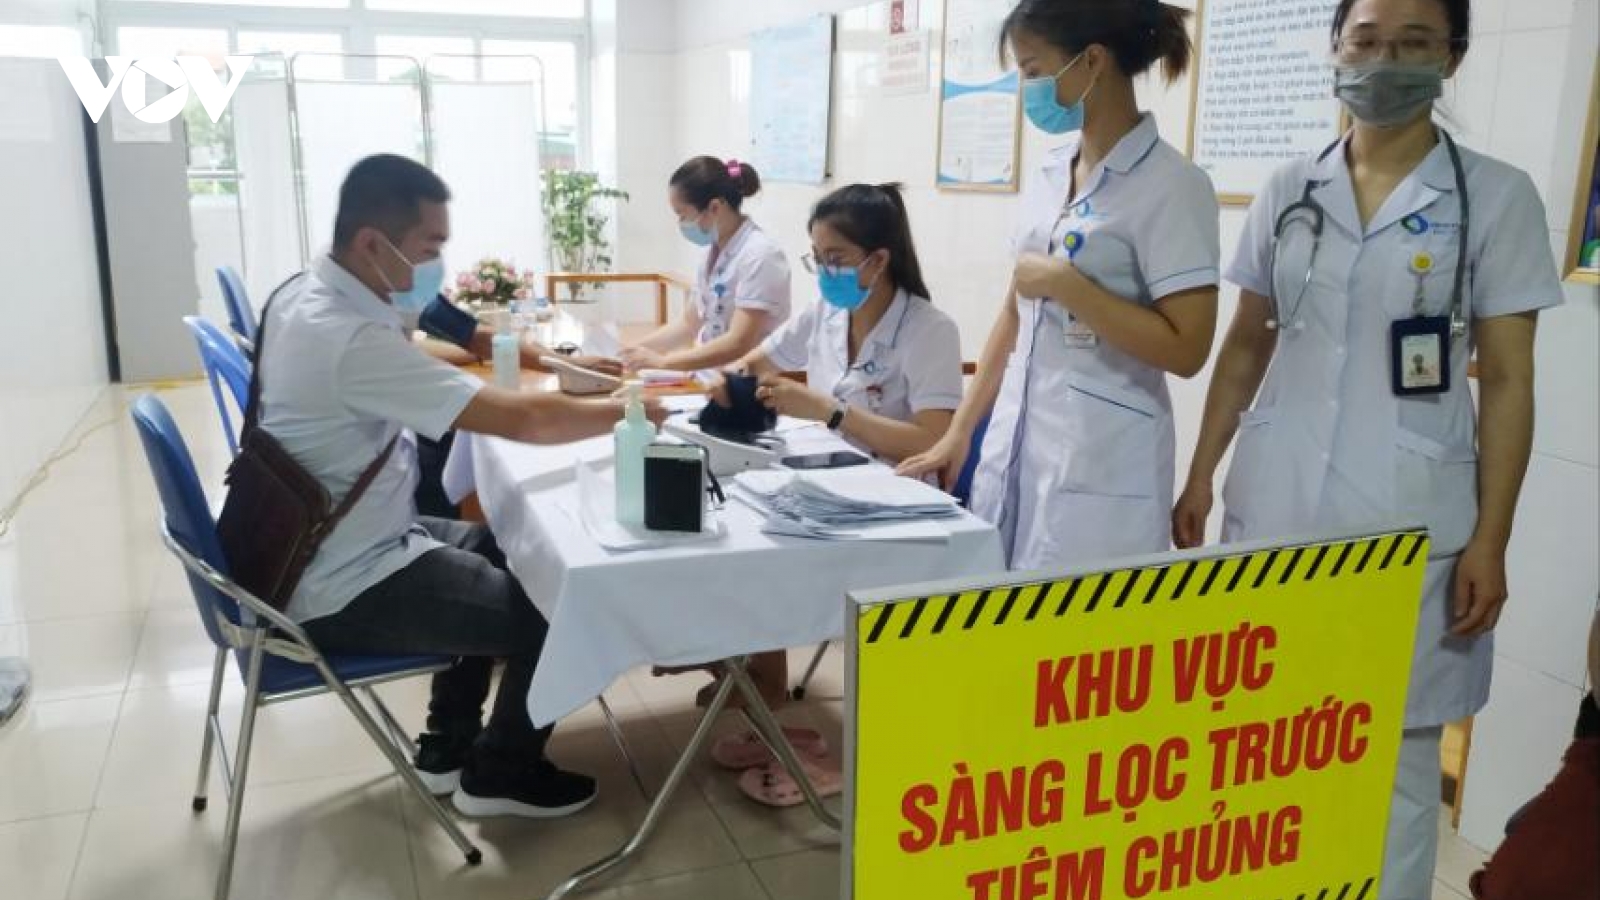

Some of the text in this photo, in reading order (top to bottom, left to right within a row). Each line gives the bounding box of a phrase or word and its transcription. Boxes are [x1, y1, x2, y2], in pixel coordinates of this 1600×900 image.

[1034, 621, 1277, 728] KHU VỰC
[899, 696, 1371, 853] SÀNG LỌC TRƯỚC
[1124, 801, 1302, 899] CHỦNG
